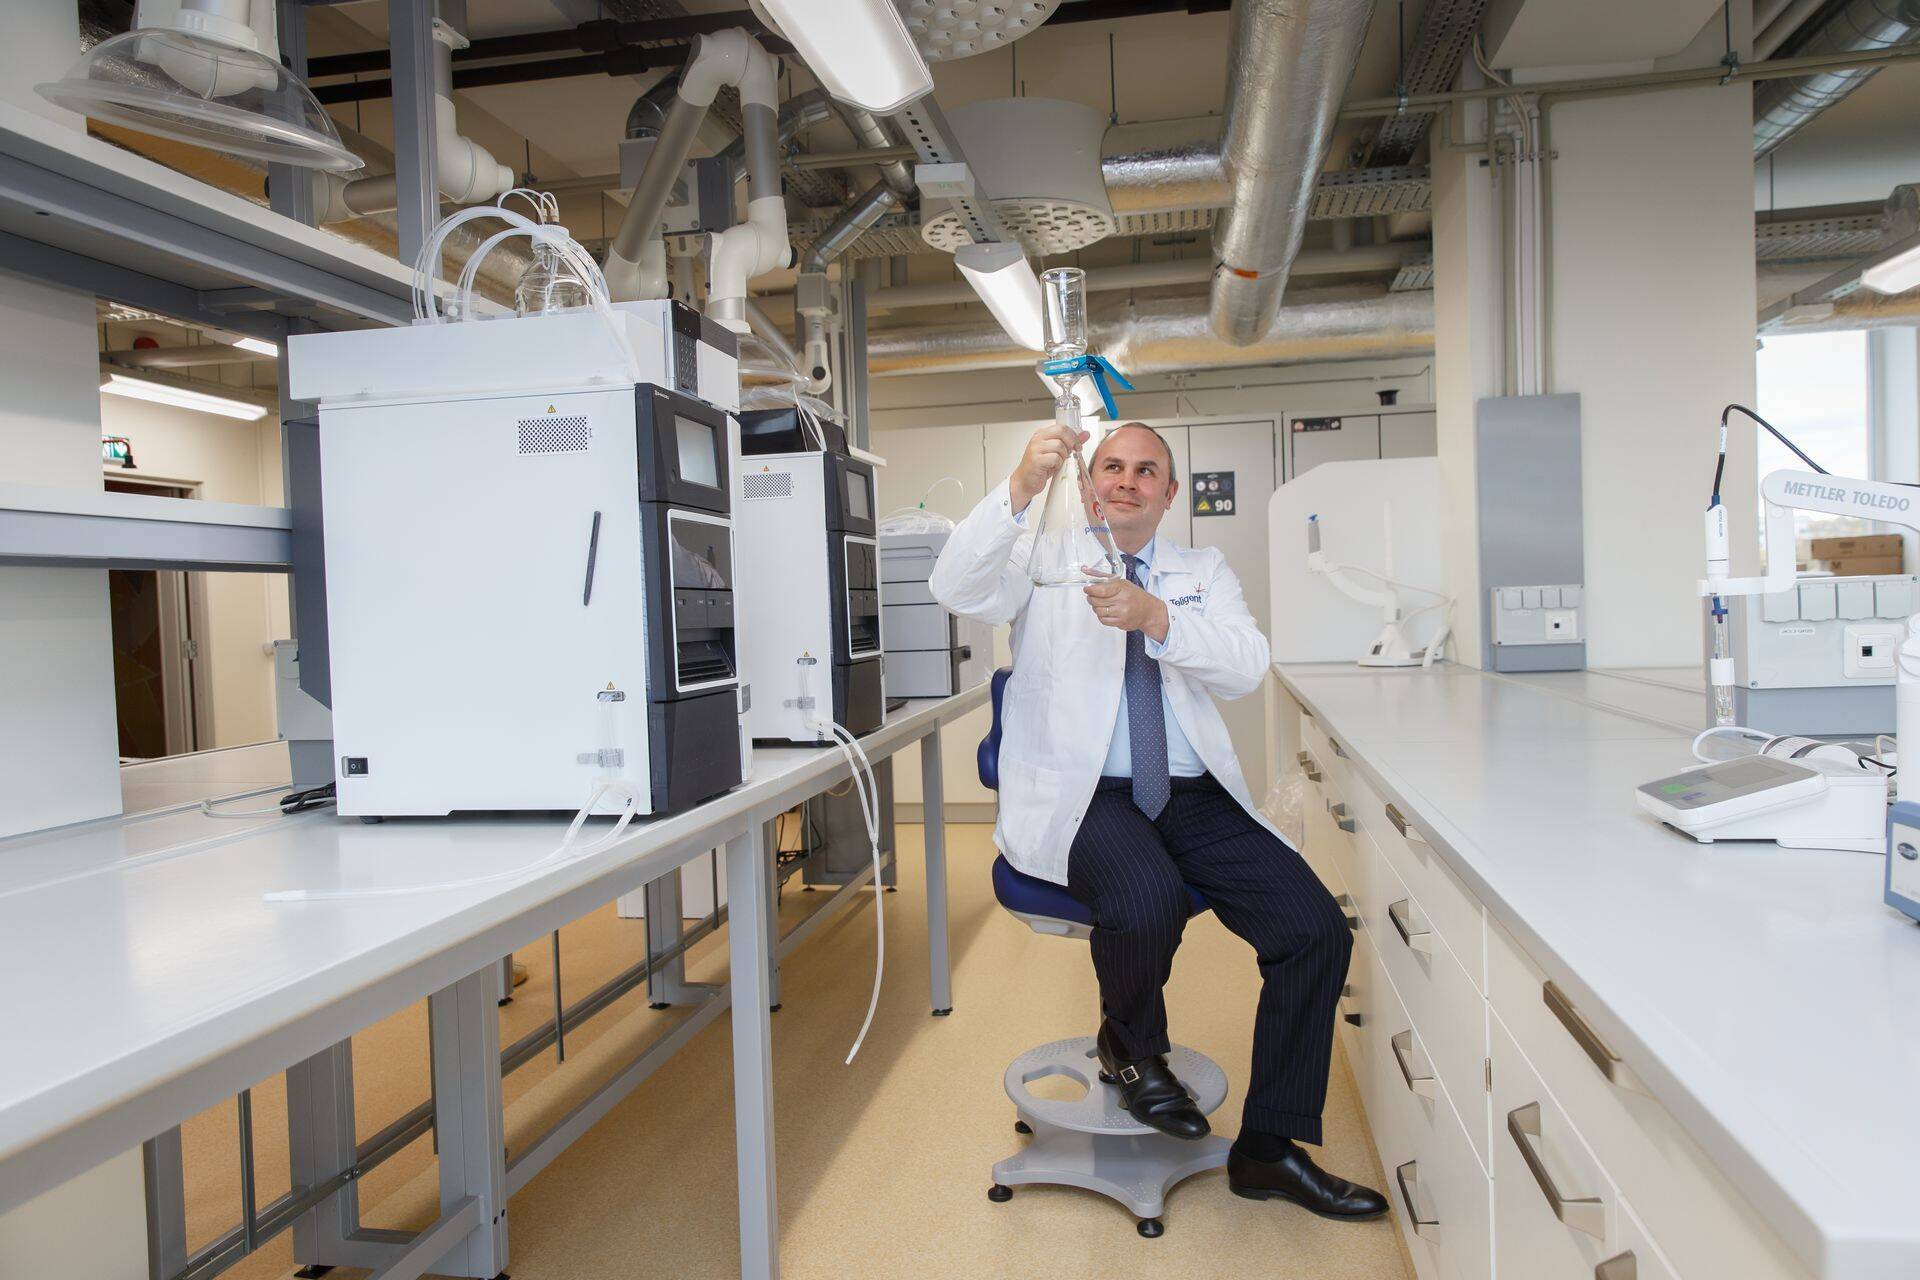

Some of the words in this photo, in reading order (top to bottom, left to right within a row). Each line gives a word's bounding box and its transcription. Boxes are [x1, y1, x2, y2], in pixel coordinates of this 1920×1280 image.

[1783, 480, 1846, 502] METTLER
[1852, 491, 1910, 511] TOLEDO
[1214, 499, 1232, 511] 90
[1169, 595, 1202, 606] Teligent
